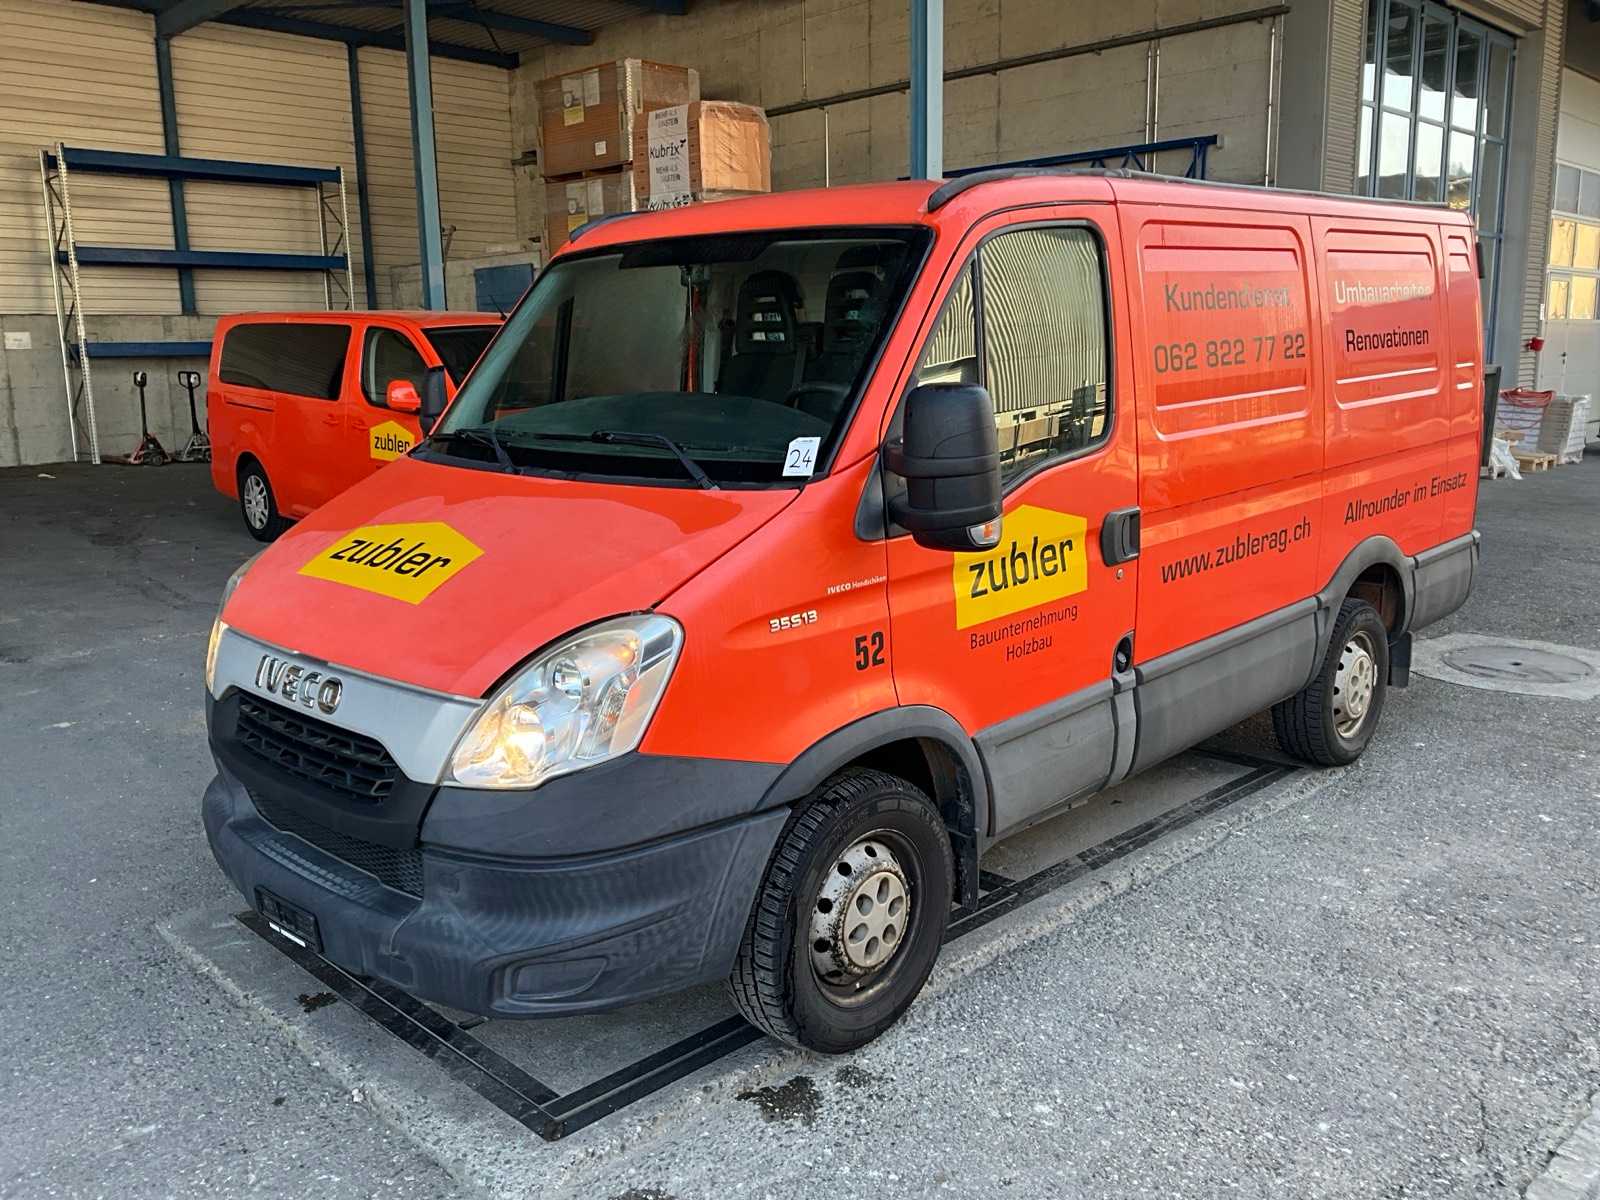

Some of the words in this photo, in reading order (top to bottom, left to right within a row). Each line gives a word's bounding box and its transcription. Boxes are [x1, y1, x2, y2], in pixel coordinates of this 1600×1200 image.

[650, 142, 680, 159] Kubrix
[1154, 341, 1198, 374] 062
[1206, 338, 1246, 368] 822
[1253, 336, 1276, 362] 77
[1283, 333, 1306, 360] 22
[1344, 326, 1430, 353] Renovationen
[374, 433, 411, 454] zubler
[789, 449, 812, 469] 24
[1344, 488, 1411, 526] Allrounder
[1413, 482, 1428, 503] im
[1430, 472, 1468, 498] Einsatz
[329, 537, 452, 578] zubler
[968, 535, 1073, 599] zubler
[1161, 516, 1311, 584] www.zublerag.ch
[827, 582, 852, 595] IVECO
[769, 609, 819, 633] 35S13
[970, 605, 1078, 650] Bauunternehmung
[855, 631, 886, 671] 52
[1006, 636, 1053, 661] Holzbau
[255, 654, 343, 715] IVECO
